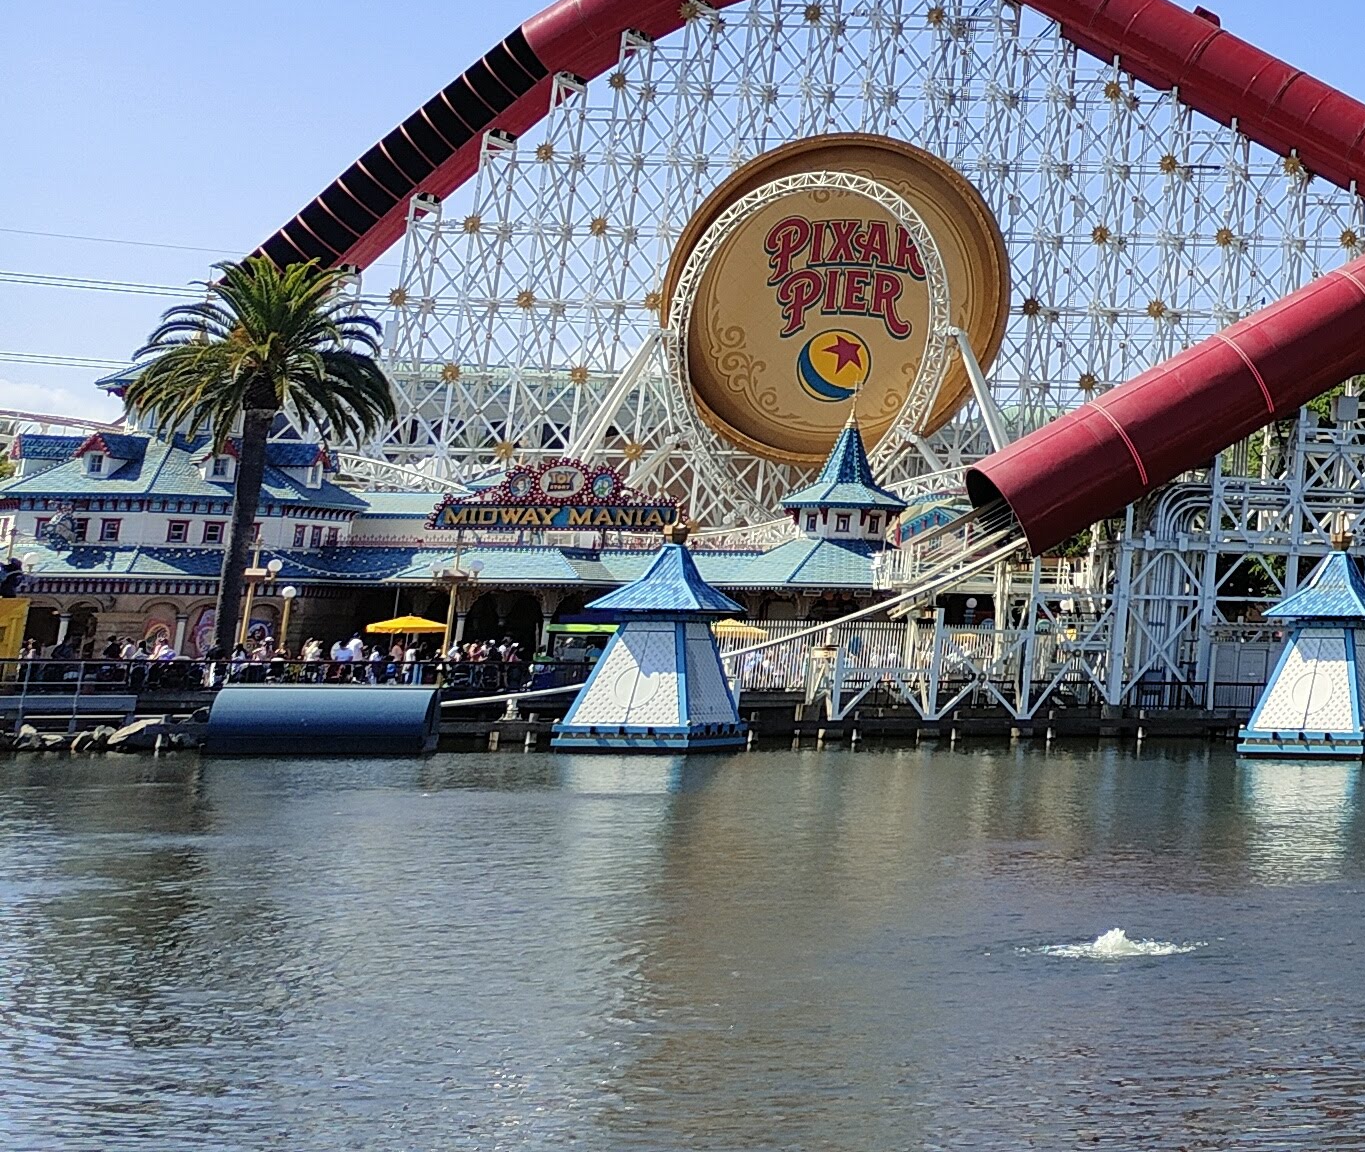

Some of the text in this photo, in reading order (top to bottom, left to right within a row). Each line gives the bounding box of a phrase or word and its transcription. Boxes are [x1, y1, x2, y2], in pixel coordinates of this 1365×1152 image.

[765, 215, 927, 285] PIXAR
[777, 267, 911, 337] PIER
[549, 471, 578, 484] TOY
[444, 507, 562, 526] MIDWAY
